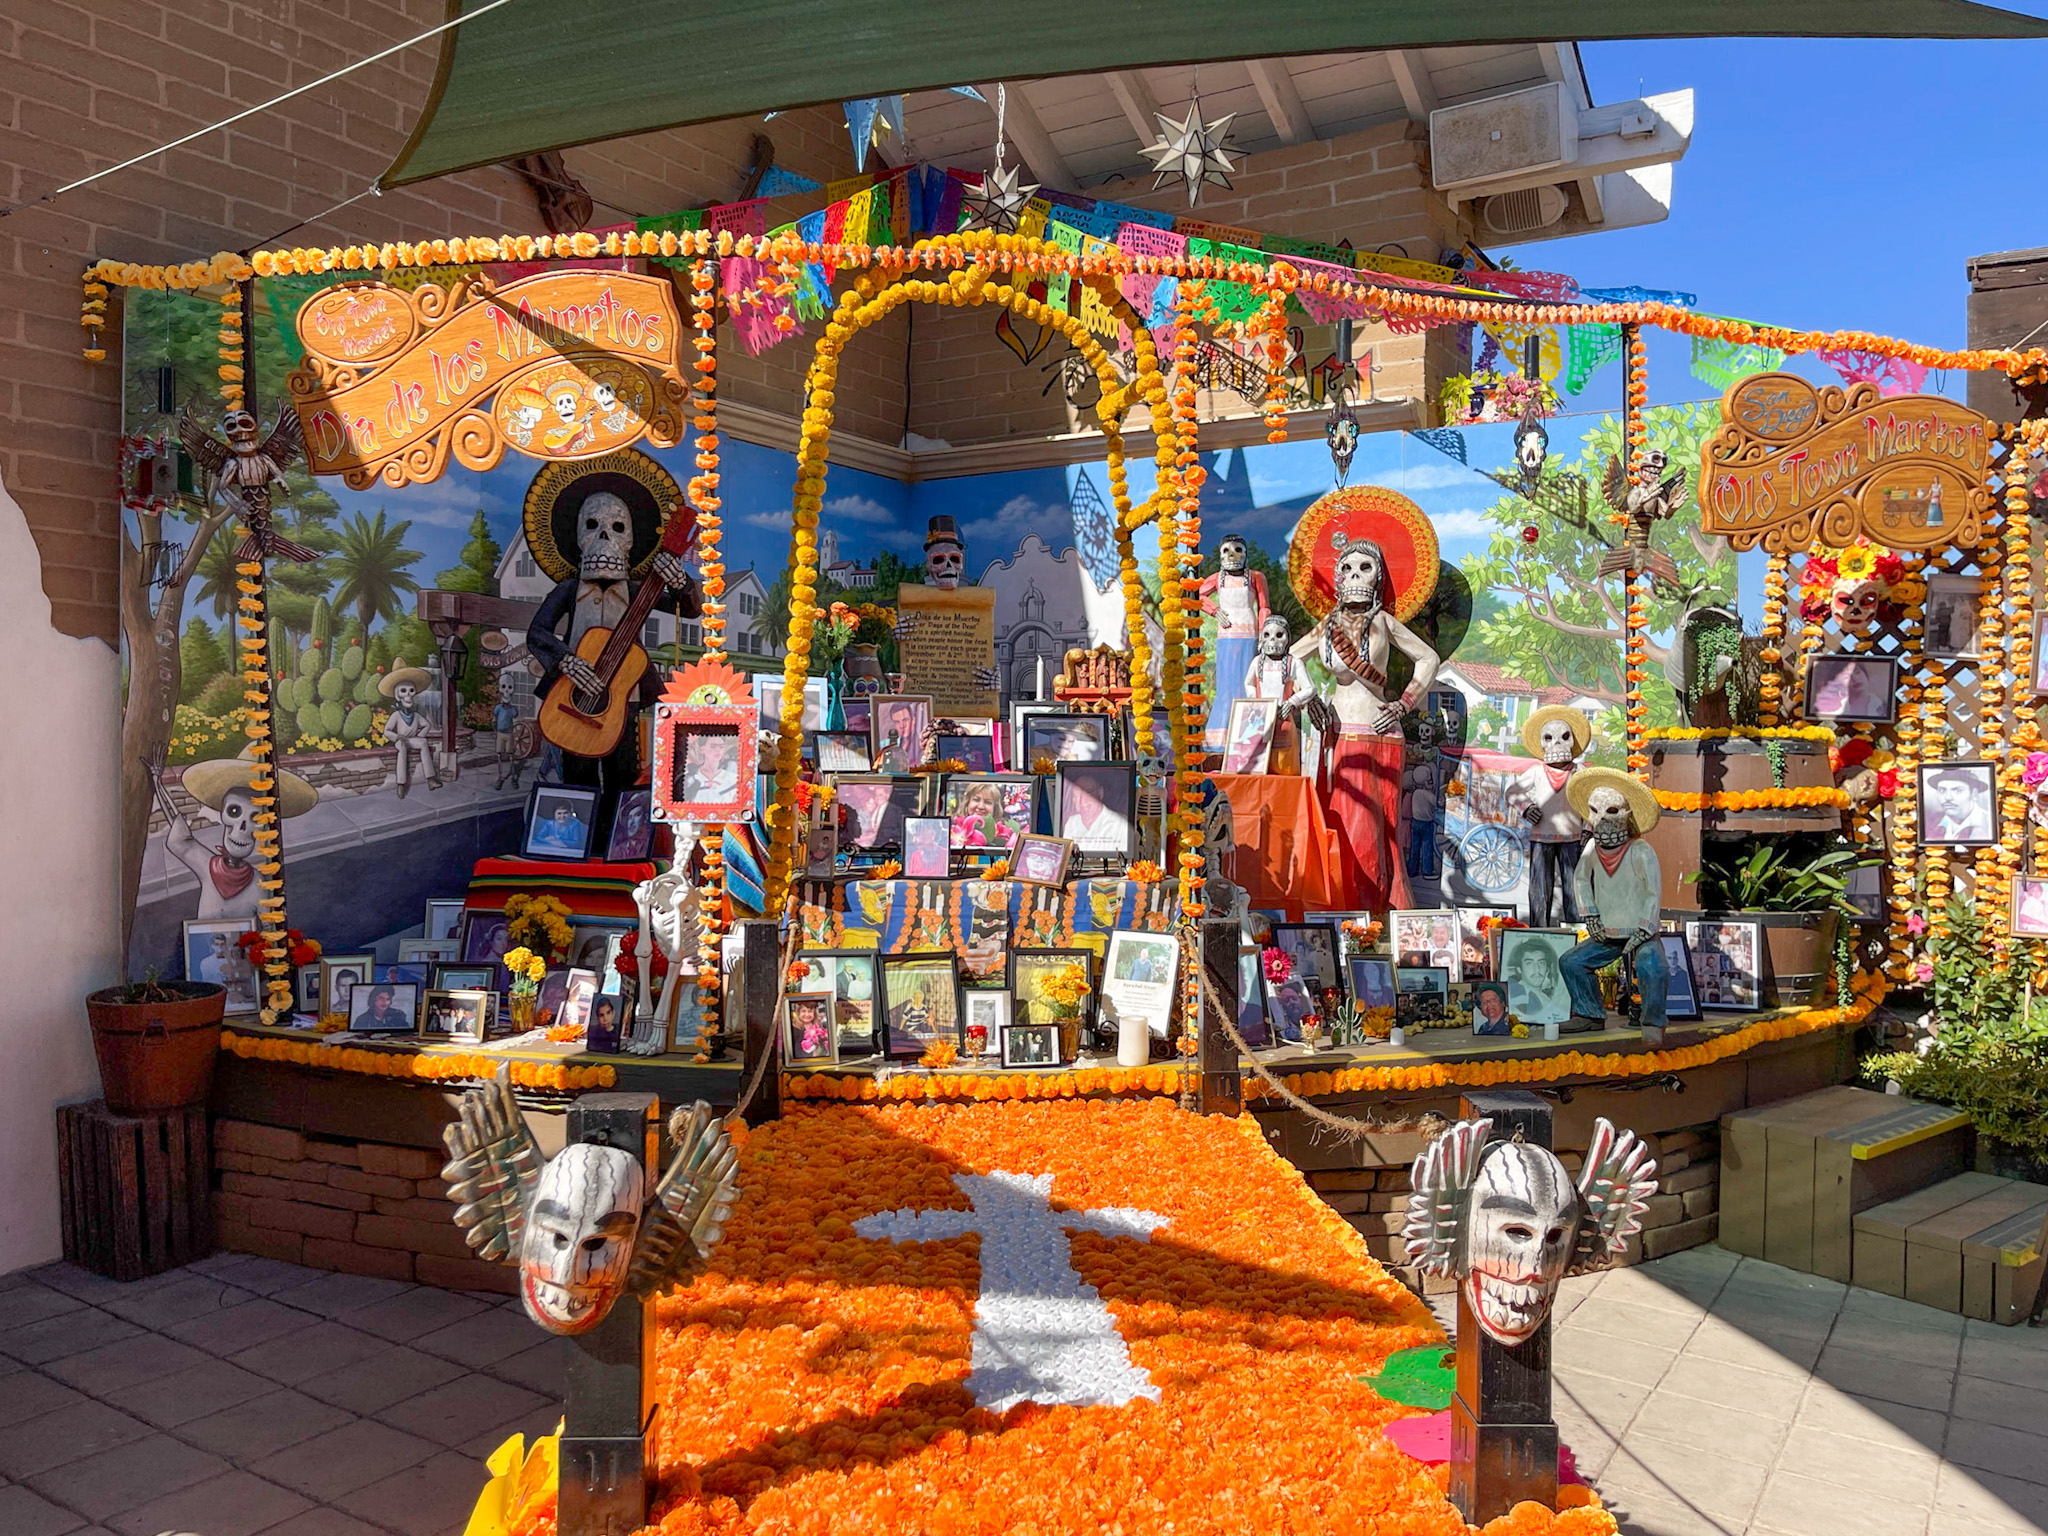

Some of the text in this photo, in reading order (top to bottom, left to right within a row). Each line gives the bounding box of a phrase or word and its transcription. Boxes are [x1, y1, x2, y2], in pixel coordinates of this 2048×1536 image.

[384, 379, 429, 440] de
[429, 339, 489, 406] los
[485, 286, 665, 362] Muertos
[1742, 387, 1790, 421] San
[1758, 398, 1816, 435] Diego
[1714, 410, 1985, 524] Old Town Market
[953, 630, 975, 638] holiday
[954, 613, 980, 623] Muertos
